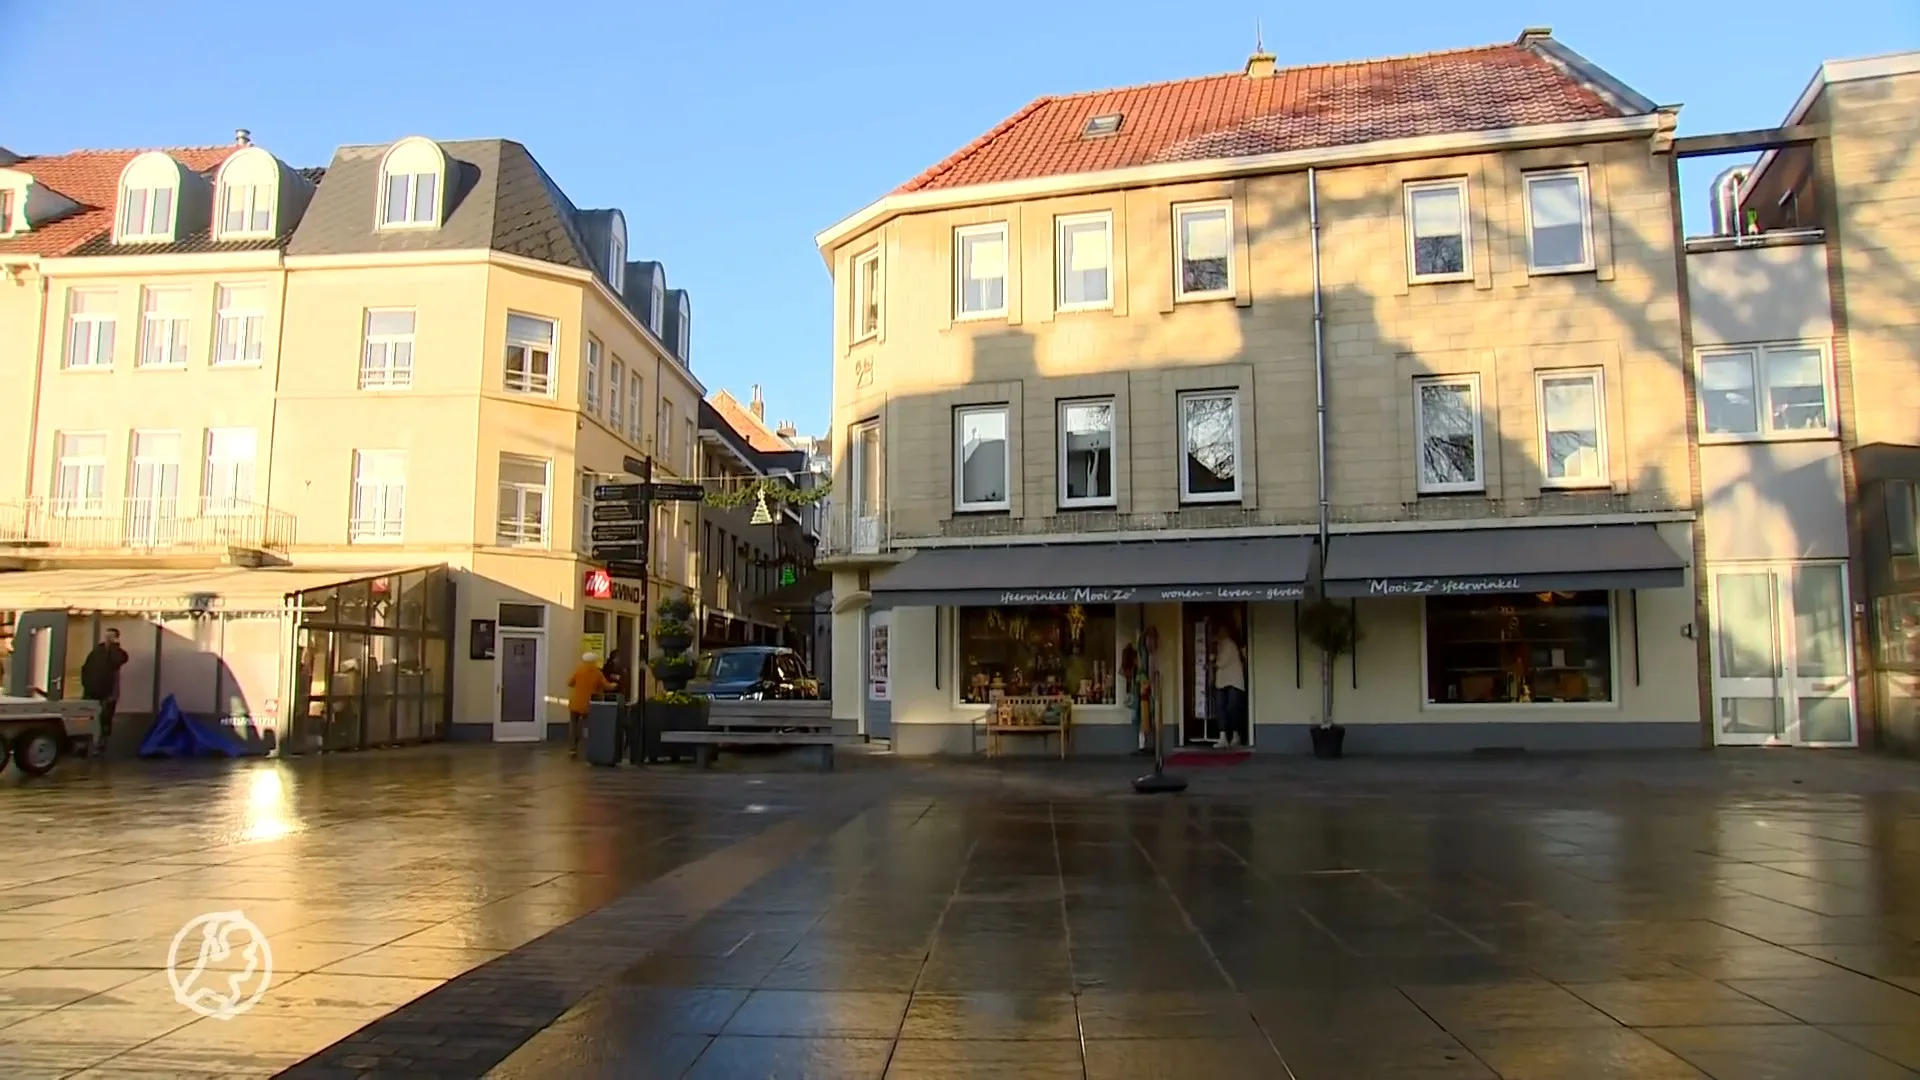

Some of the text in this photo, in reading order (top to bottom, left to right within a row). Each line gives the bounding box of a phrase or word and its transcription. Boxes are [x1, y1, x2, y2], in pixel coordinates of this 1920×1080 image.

[1441, 578, 1519, 594] sfeerwinkel
[1001, 590, 1067, 604] sfeerwinkel
[1161, 589, 1202, 599] wonen
[1218, 587, 1252, 598] leven
[1266, 588, 1304, 600] geven
